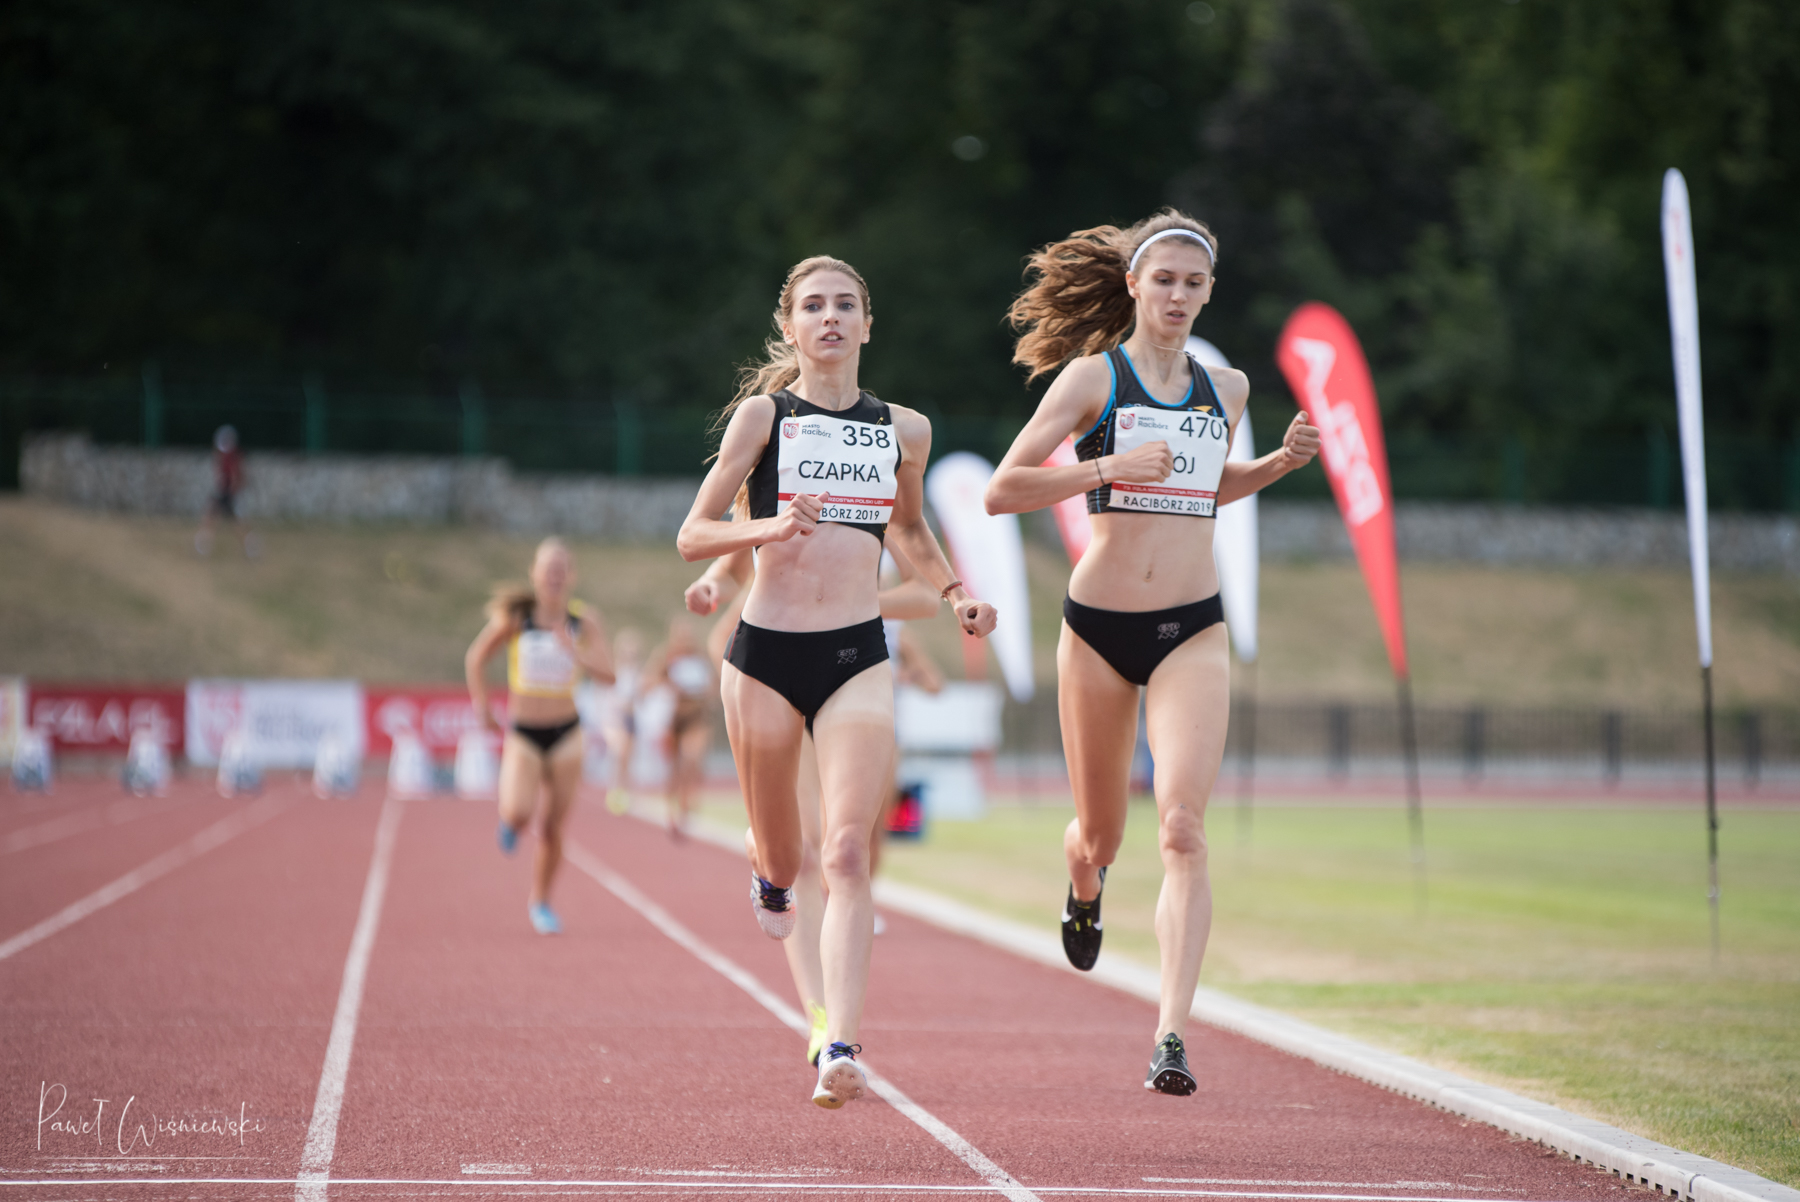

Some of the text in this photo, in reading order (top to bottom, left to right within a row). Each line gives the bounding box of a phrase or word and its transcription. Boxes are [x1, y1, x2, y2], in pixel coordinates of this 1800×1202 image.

[801, 428, 832, 438] Racibórz
[1138, 420, 1169, 430] Racibórz
[1179, 416, 1223, 440] 470
[842, 425, 890, 449] 358
[798, 460, 881, 483] CZAPKA
[821, 504, 880, 520] BÓRZ 2019
[1123, 495, 1212, 513] RACIBÓRZ 2019
